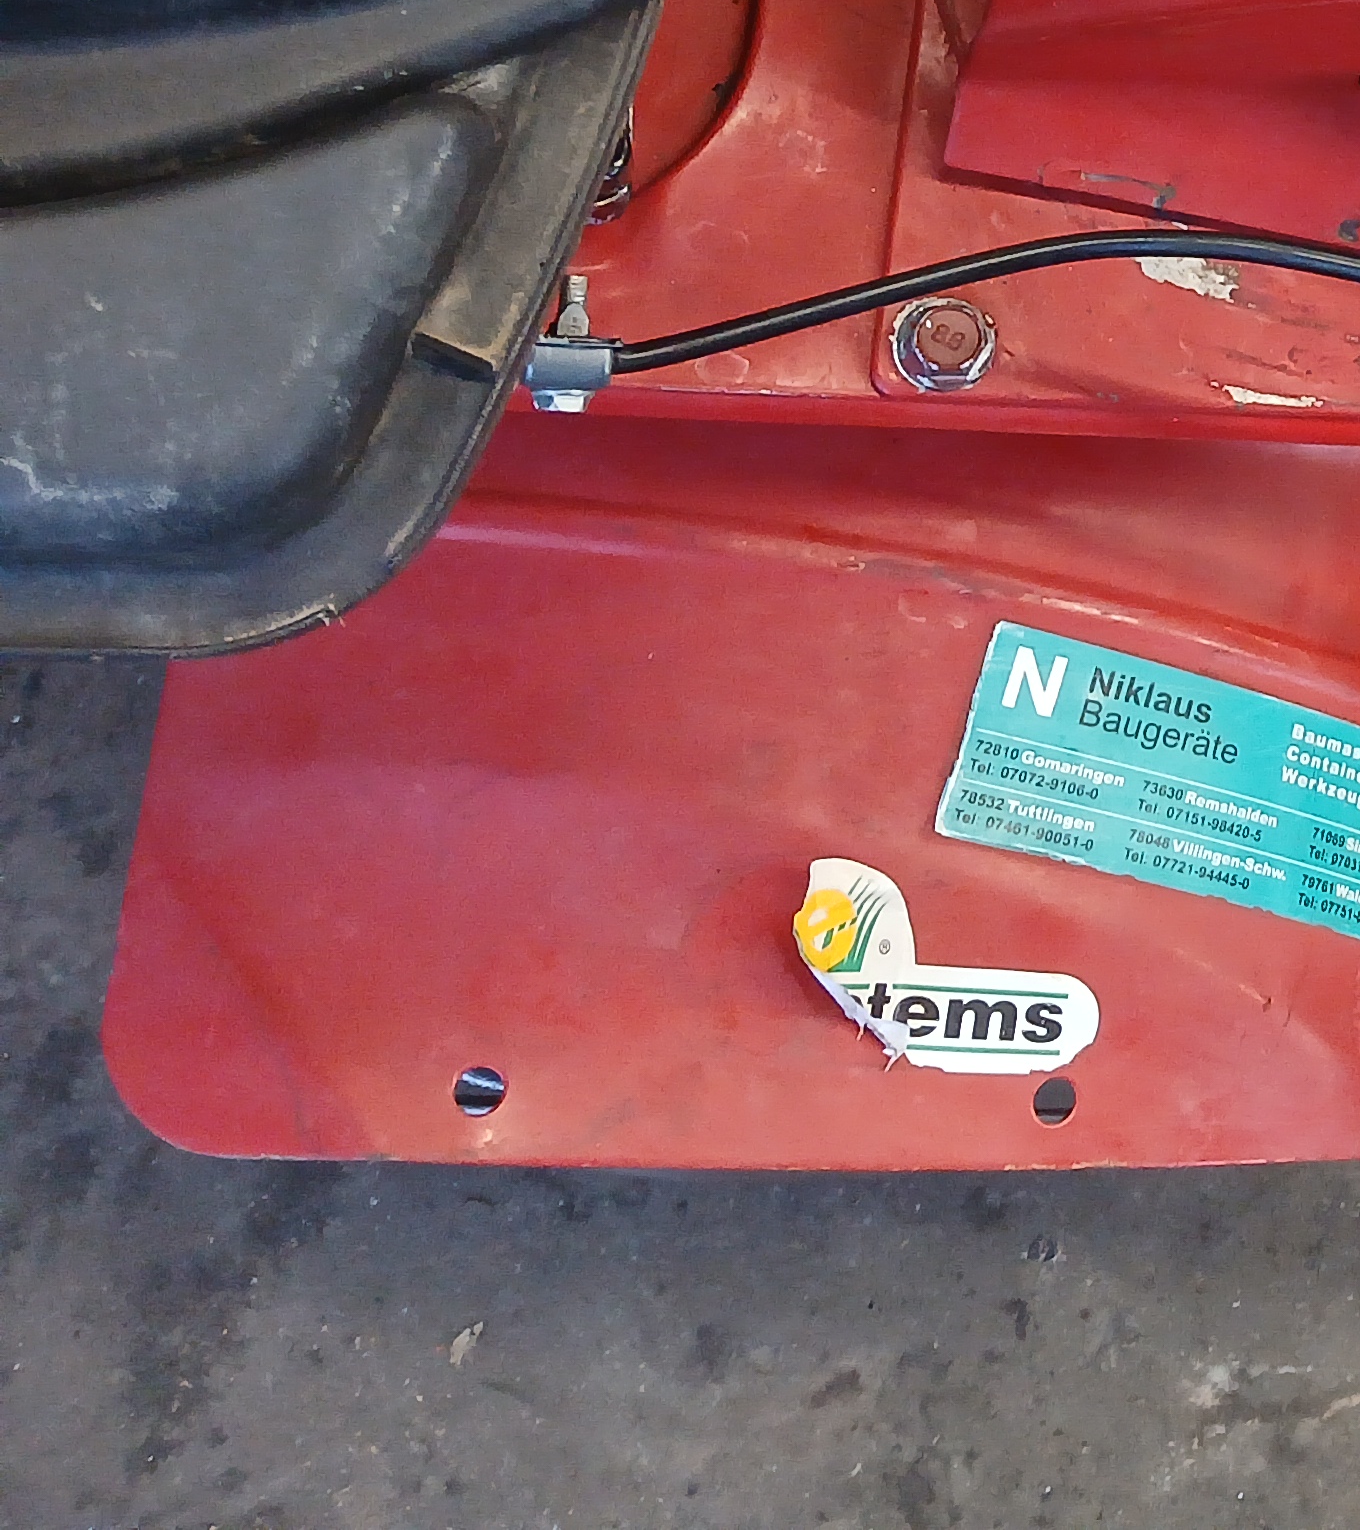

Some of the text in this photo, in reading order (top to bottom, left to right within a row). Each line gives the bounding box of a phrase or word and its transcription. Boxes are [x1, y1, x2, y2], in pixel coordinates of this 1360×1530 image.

[1001, 645, 1069, 718] N
[1089, 666, 1213, 724] Niklaus
[1079, 698, 1239, 764] Baugeräte
[975, 739, 1125, 787] 72810 Gomaringen
[1000, 766, 1099, 800] 07072-9106-0
[960, 789, 1095, 832] 78532 Tuttlingen
[1185, 790, 1278, 828] Remshalden
[1172, 838, 1287, 881] Villingen-Schw.
[847, 983, 1062, 1043] tems
